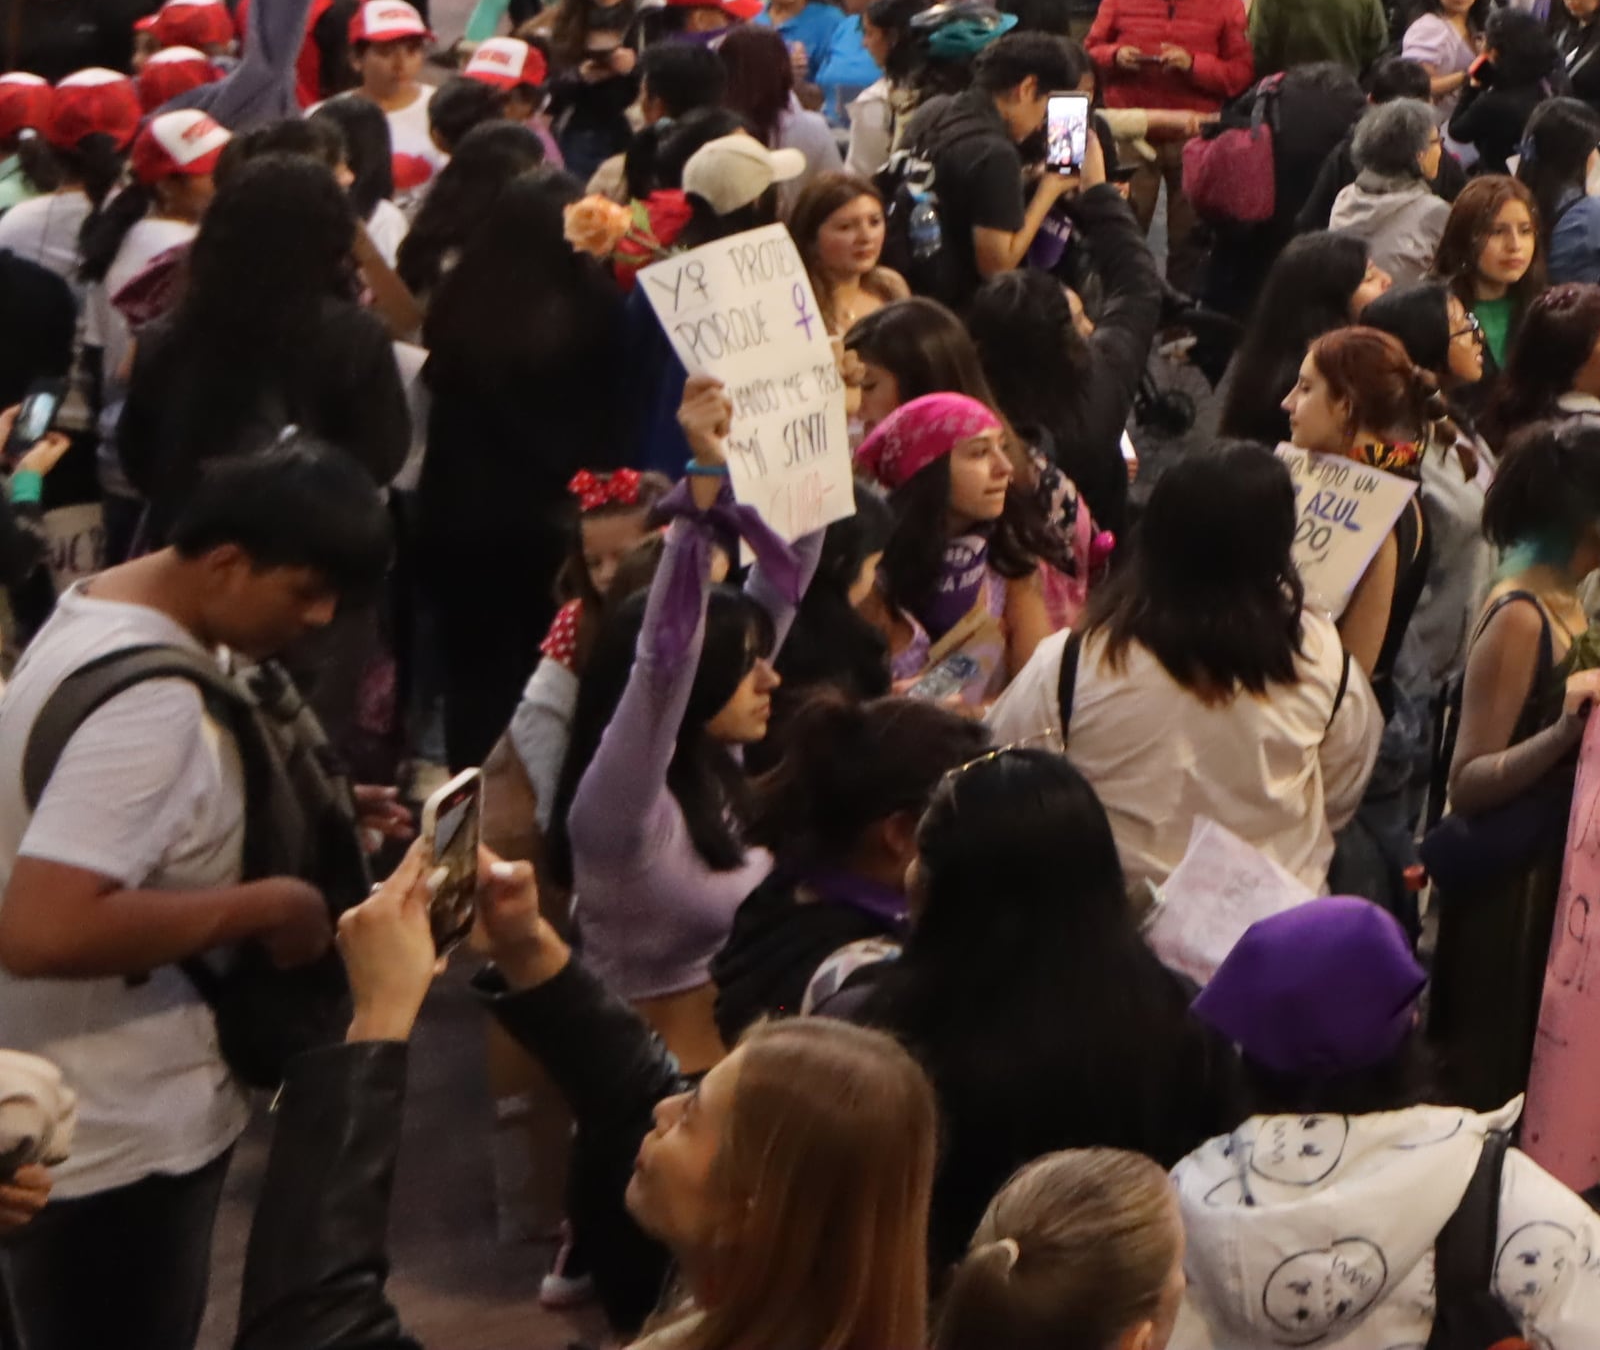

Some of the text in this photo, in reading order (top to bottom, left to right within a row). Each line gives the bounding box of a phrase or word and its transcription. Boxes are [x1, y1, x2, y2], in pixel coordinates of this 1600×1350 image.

[673, 299, 771, 366] PORQUE
[728, 378, 780, 419] UANDO
[1353, 473, 1380, 494] UN
[1303, 491, 1361, 532] AZUL
